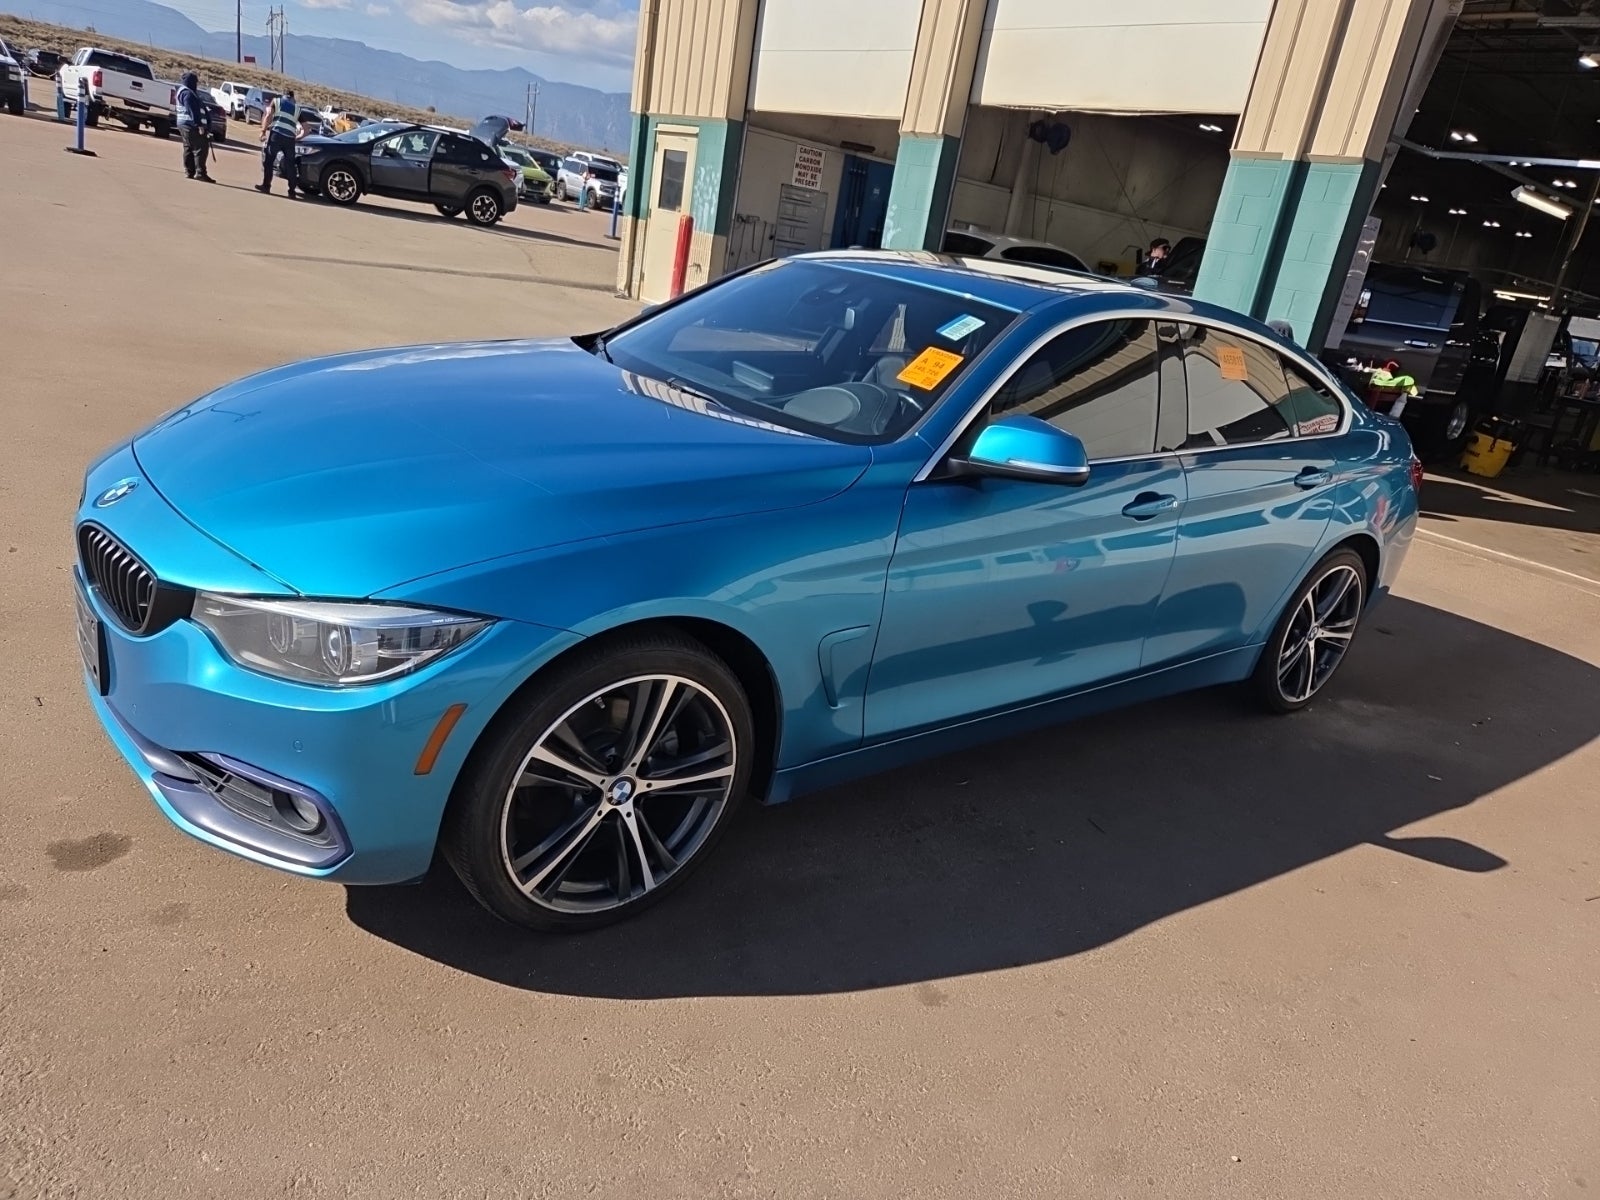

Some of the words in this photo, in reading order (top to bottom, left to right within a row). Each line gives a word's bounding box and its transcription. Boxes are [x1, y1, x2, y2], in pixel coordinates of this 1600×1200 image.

[800, 147, 823, 158] CAUTION
[799, 156, 821, 166] CARBON
[794, 162, 822, 175] MONOXIDE
[797, 171, 809, 179] MAY
[810, 173, 818, 181] BE
[794, 178, 818, 188] PRESENT
